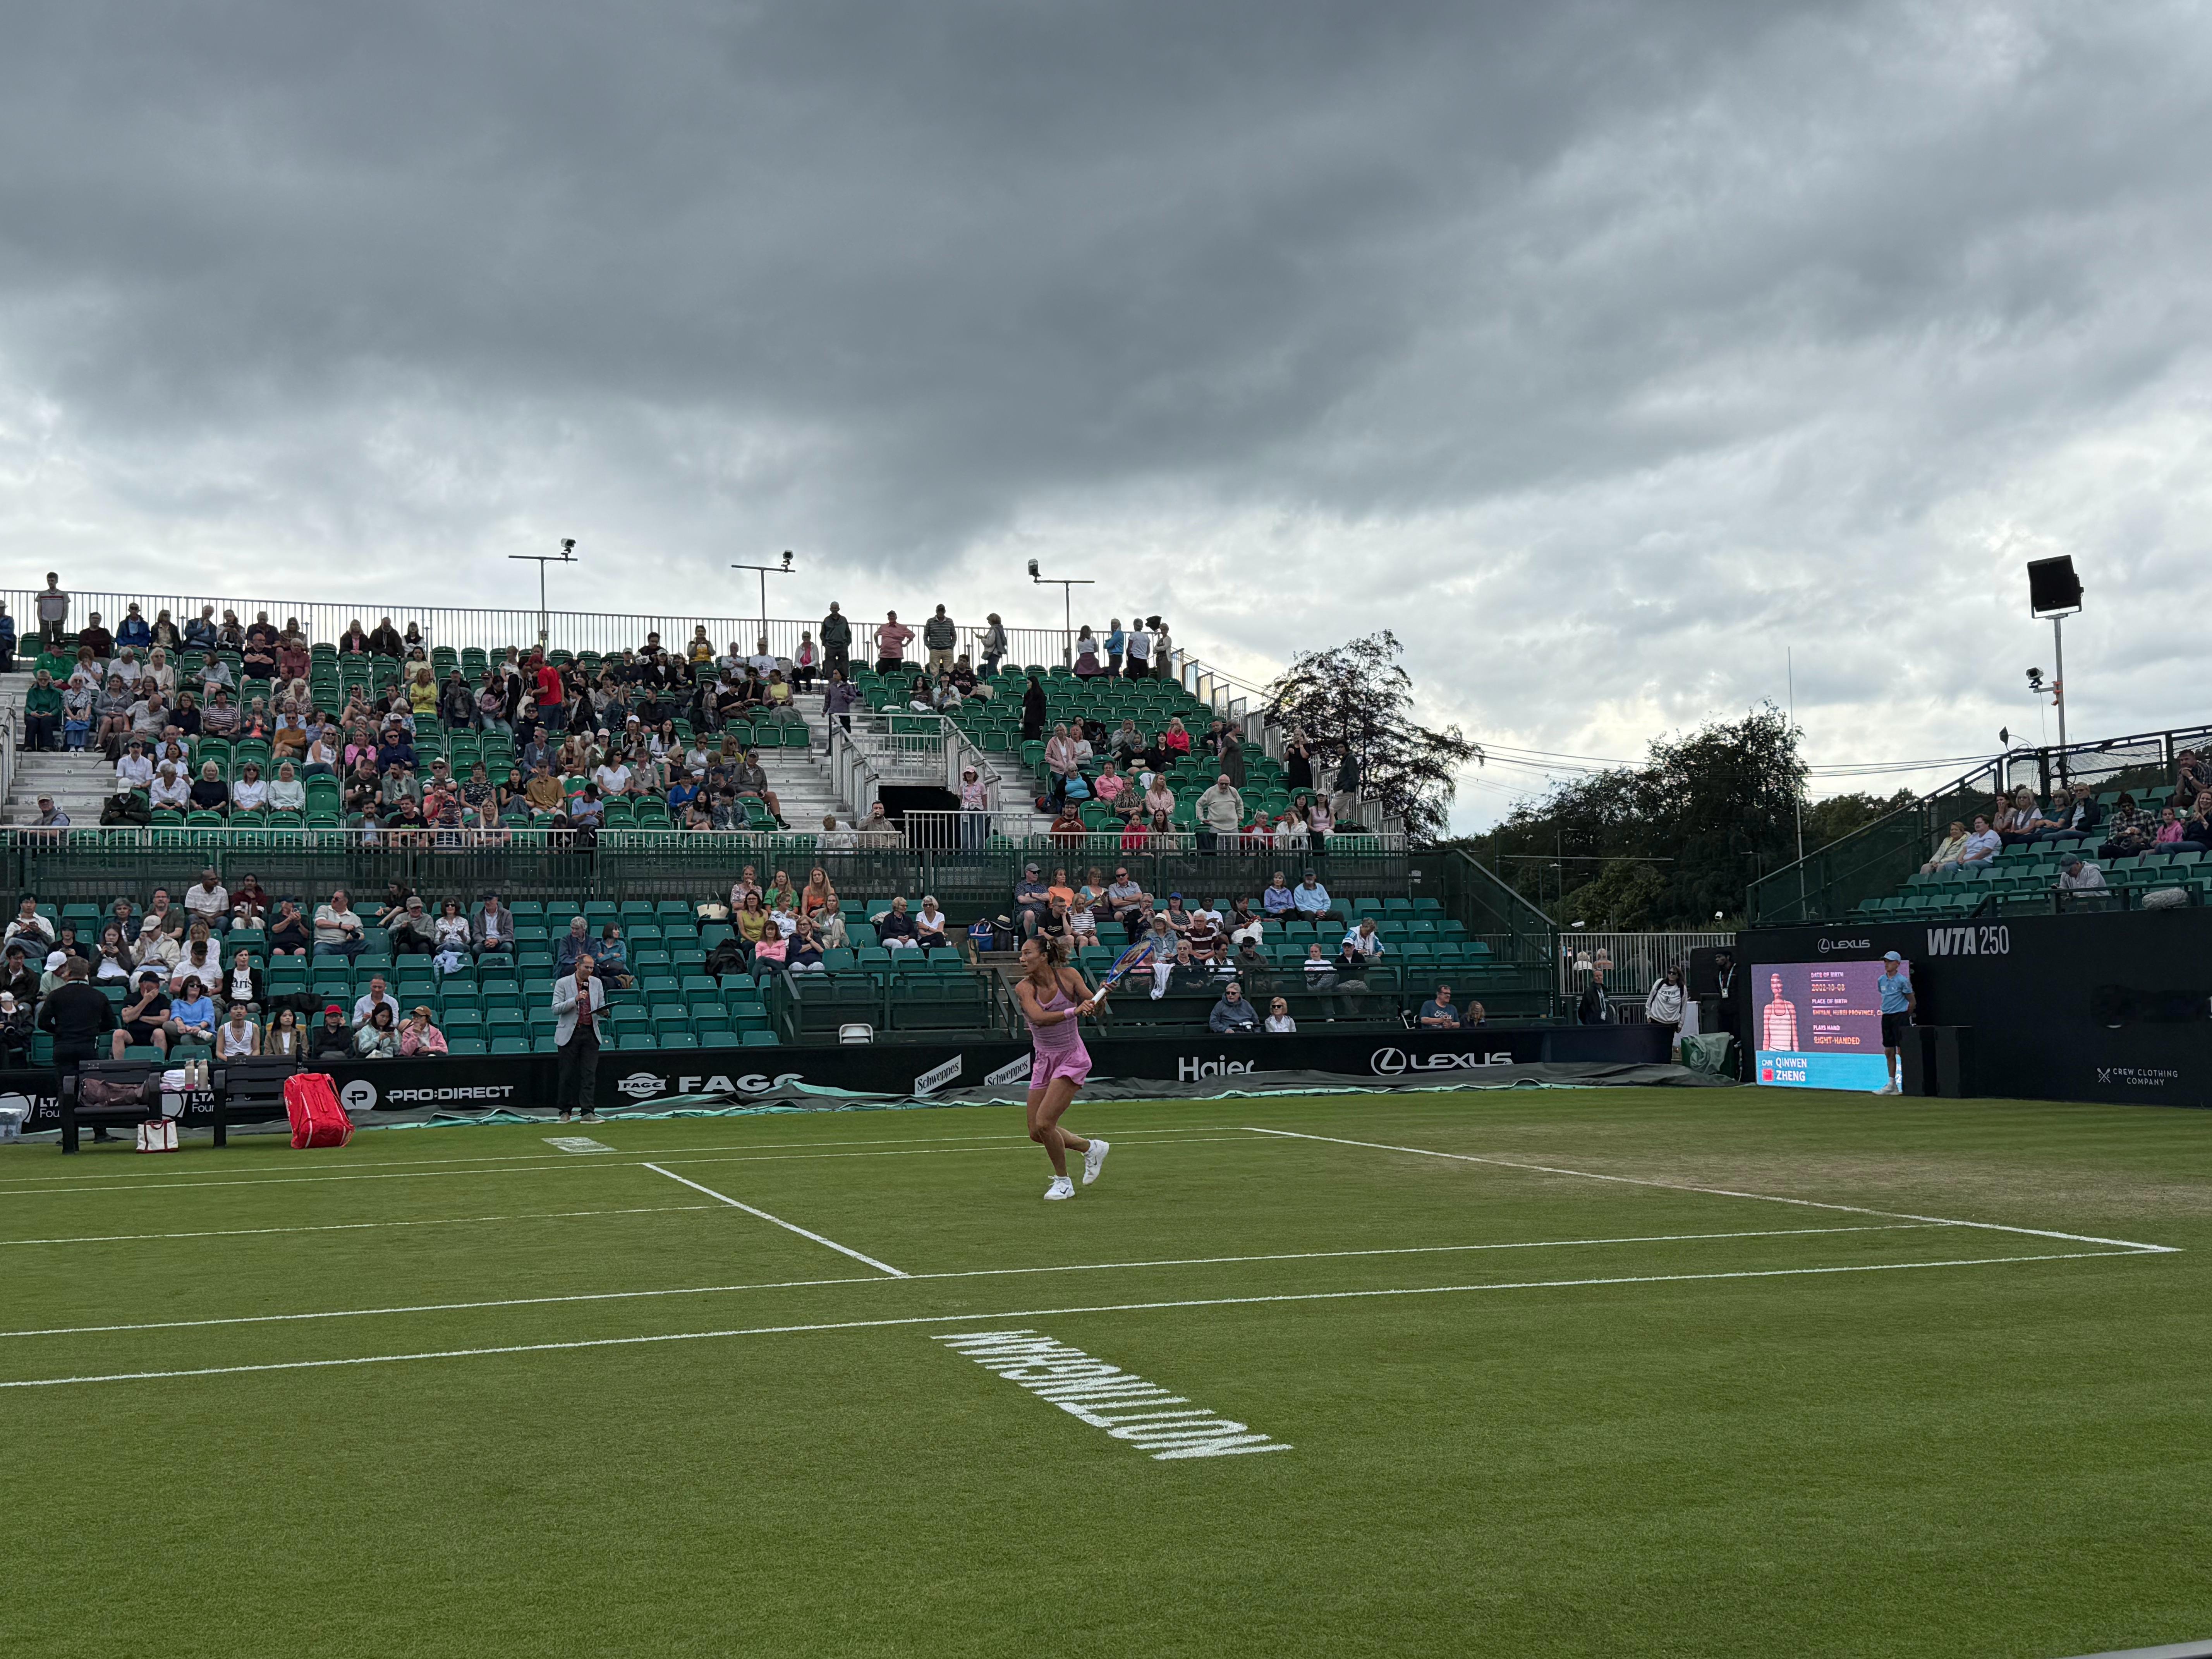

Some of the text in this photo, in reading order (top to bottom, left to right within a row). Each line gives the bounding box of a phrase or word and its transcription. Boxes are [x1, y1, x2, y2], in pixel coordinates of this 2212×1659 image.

[1831, 939, 1870, 949] LEXUS
[1927, 925, 2009, 956] WTA 250
[1814, 1036, 1860, 1045] RIGHT-HANDED
[1178, 1054, 1254, 1081] Haier
[1410, 1053, 1513, 1069] LEXUS
[1776, 1057, 1807, 1068] QINWEN
[917, 1061, 959, 1091] Schweppes
[988, 1060, 1028, 1086] Schweppes
[1776, 1070, 1806, 1082] ZHENG
[2138, 1068, 2178, 1078] CLOTHING
[2126, 1077, 2164, 1085] COMPANY
[930, 1329, 1294, 1461] NOTTINGHAM
